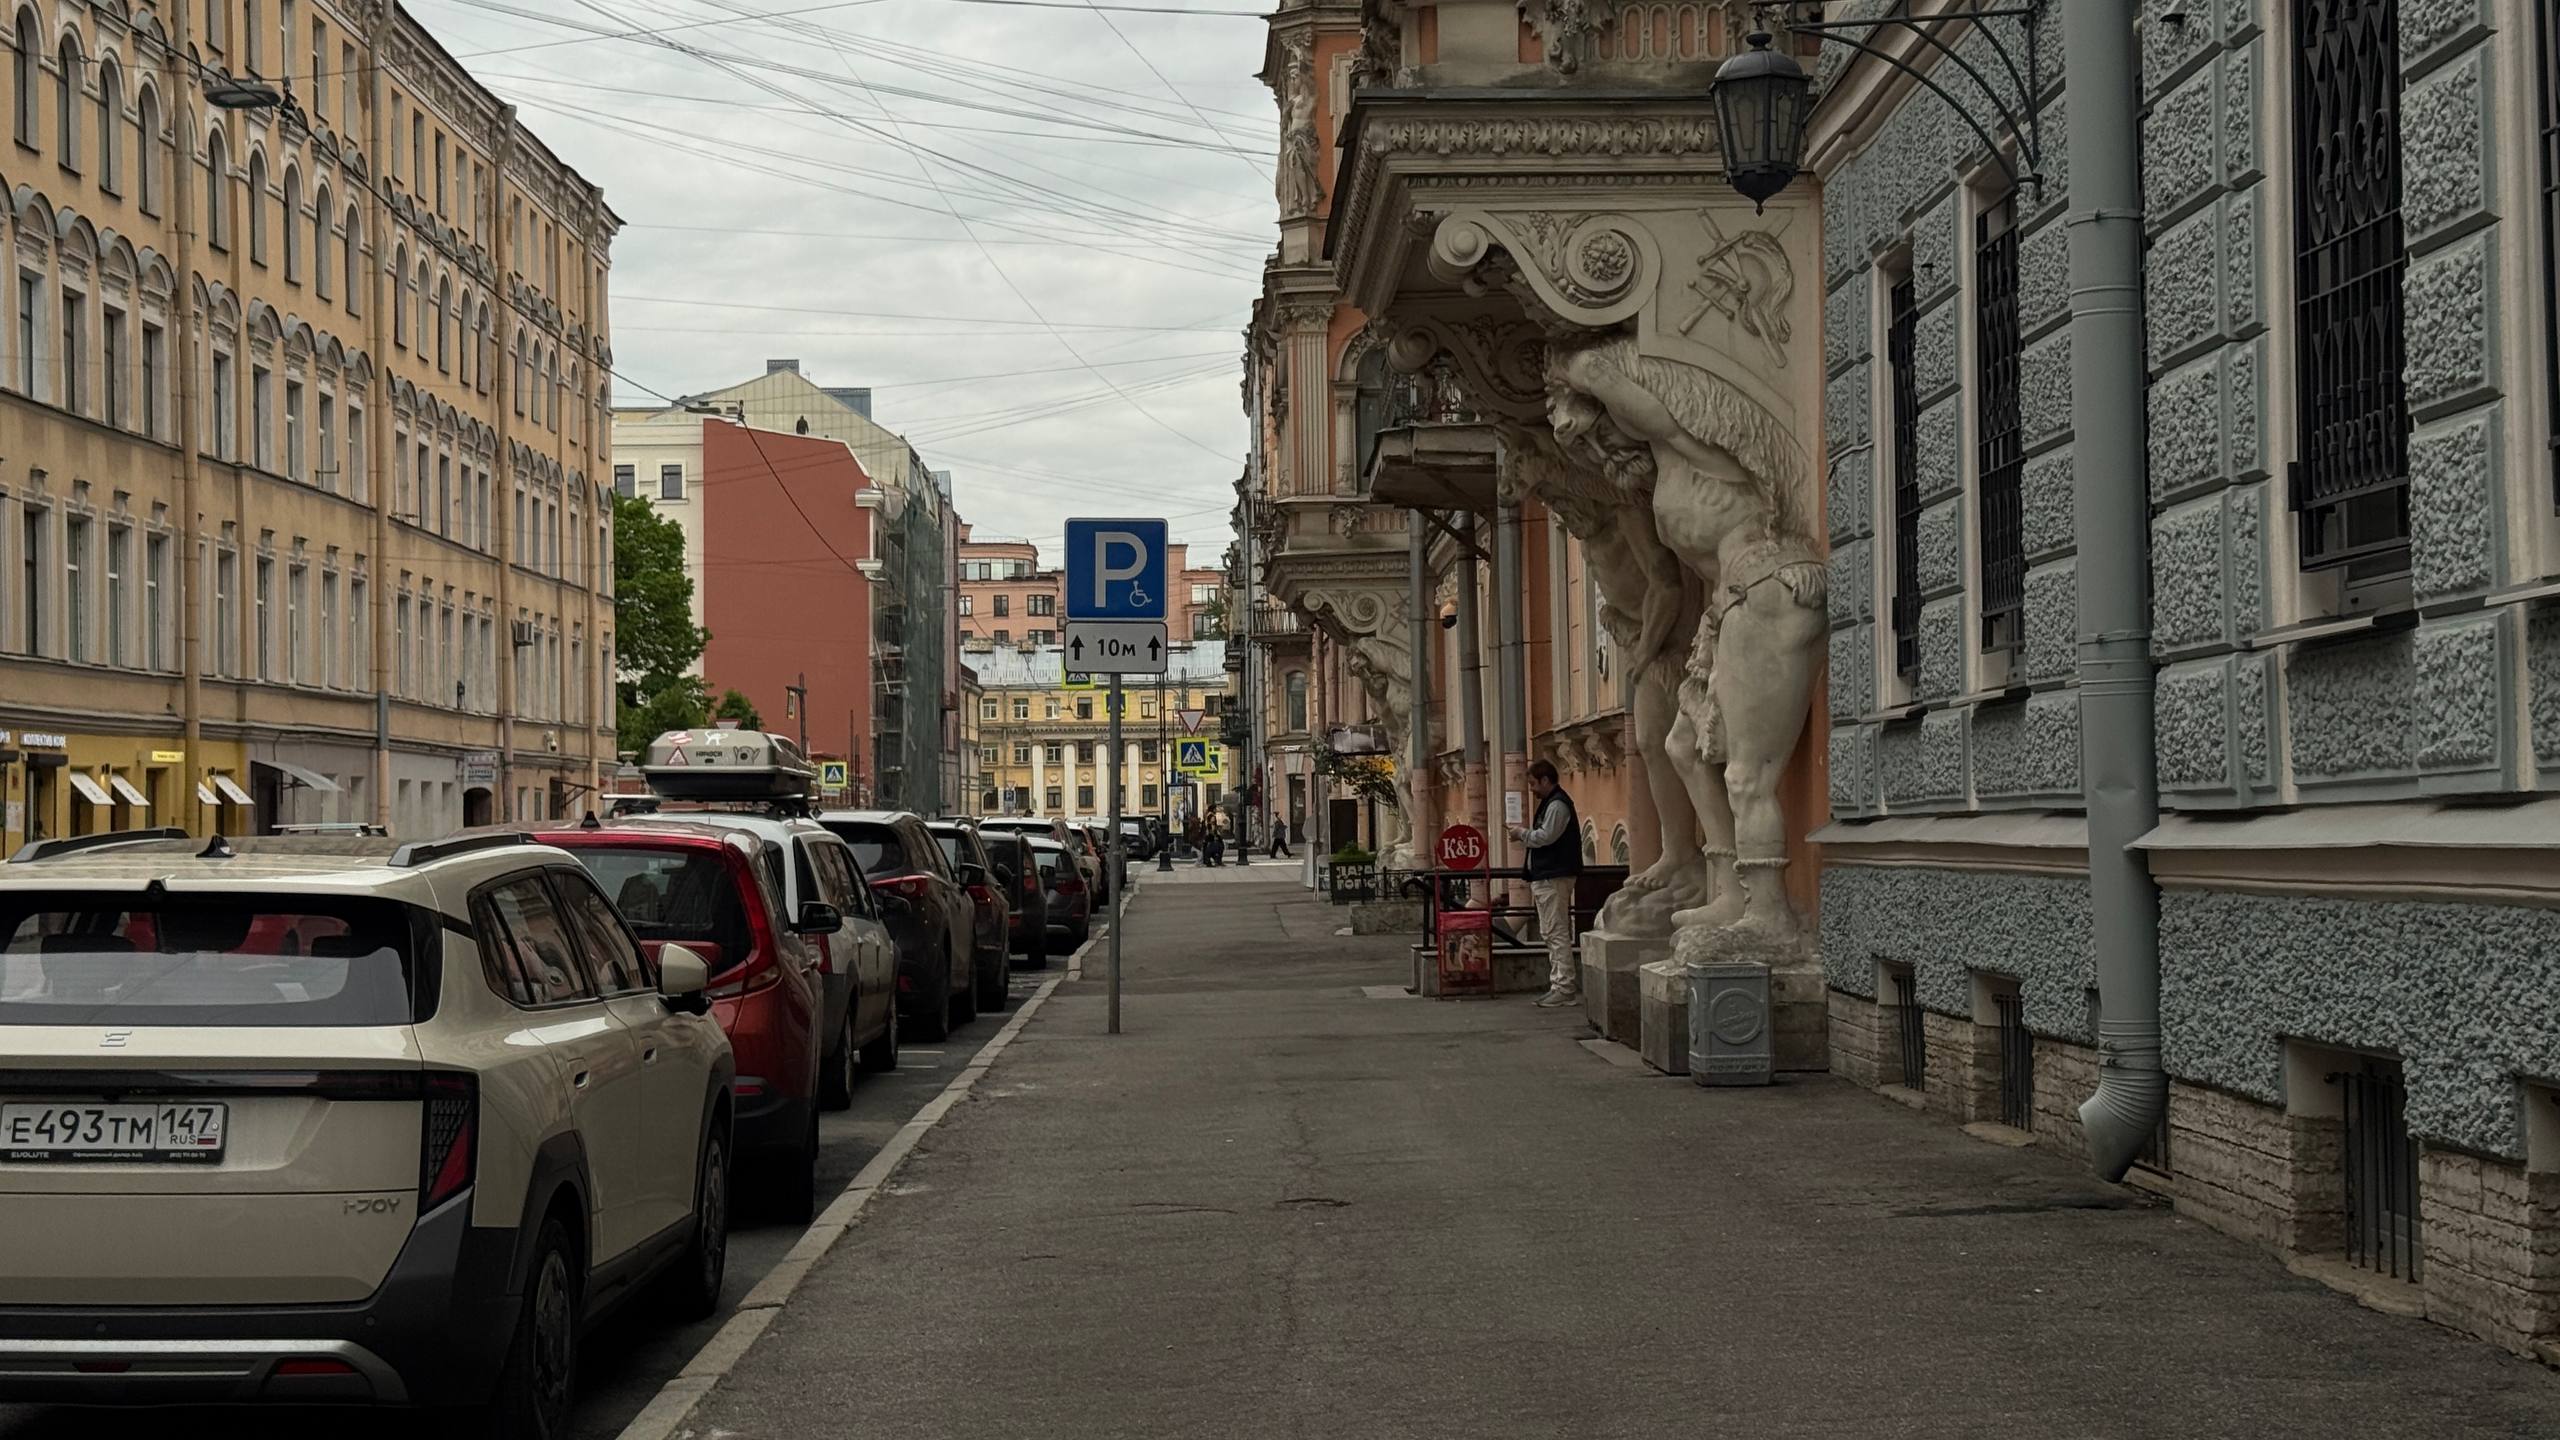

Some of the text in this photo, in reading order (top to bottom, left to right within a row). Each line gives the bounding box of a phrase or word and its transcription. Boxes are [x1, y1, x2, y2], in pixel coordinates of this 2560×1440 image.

[1095, 531, 1148, 608] P
[1442, 836, 1480, 860] К&Б
[11, 1108, 214, 1144] Е493ТМ 147
[170, 1134, 197, 1145] RUS
[11, 1151, 49, 1159] EVOLUTE
